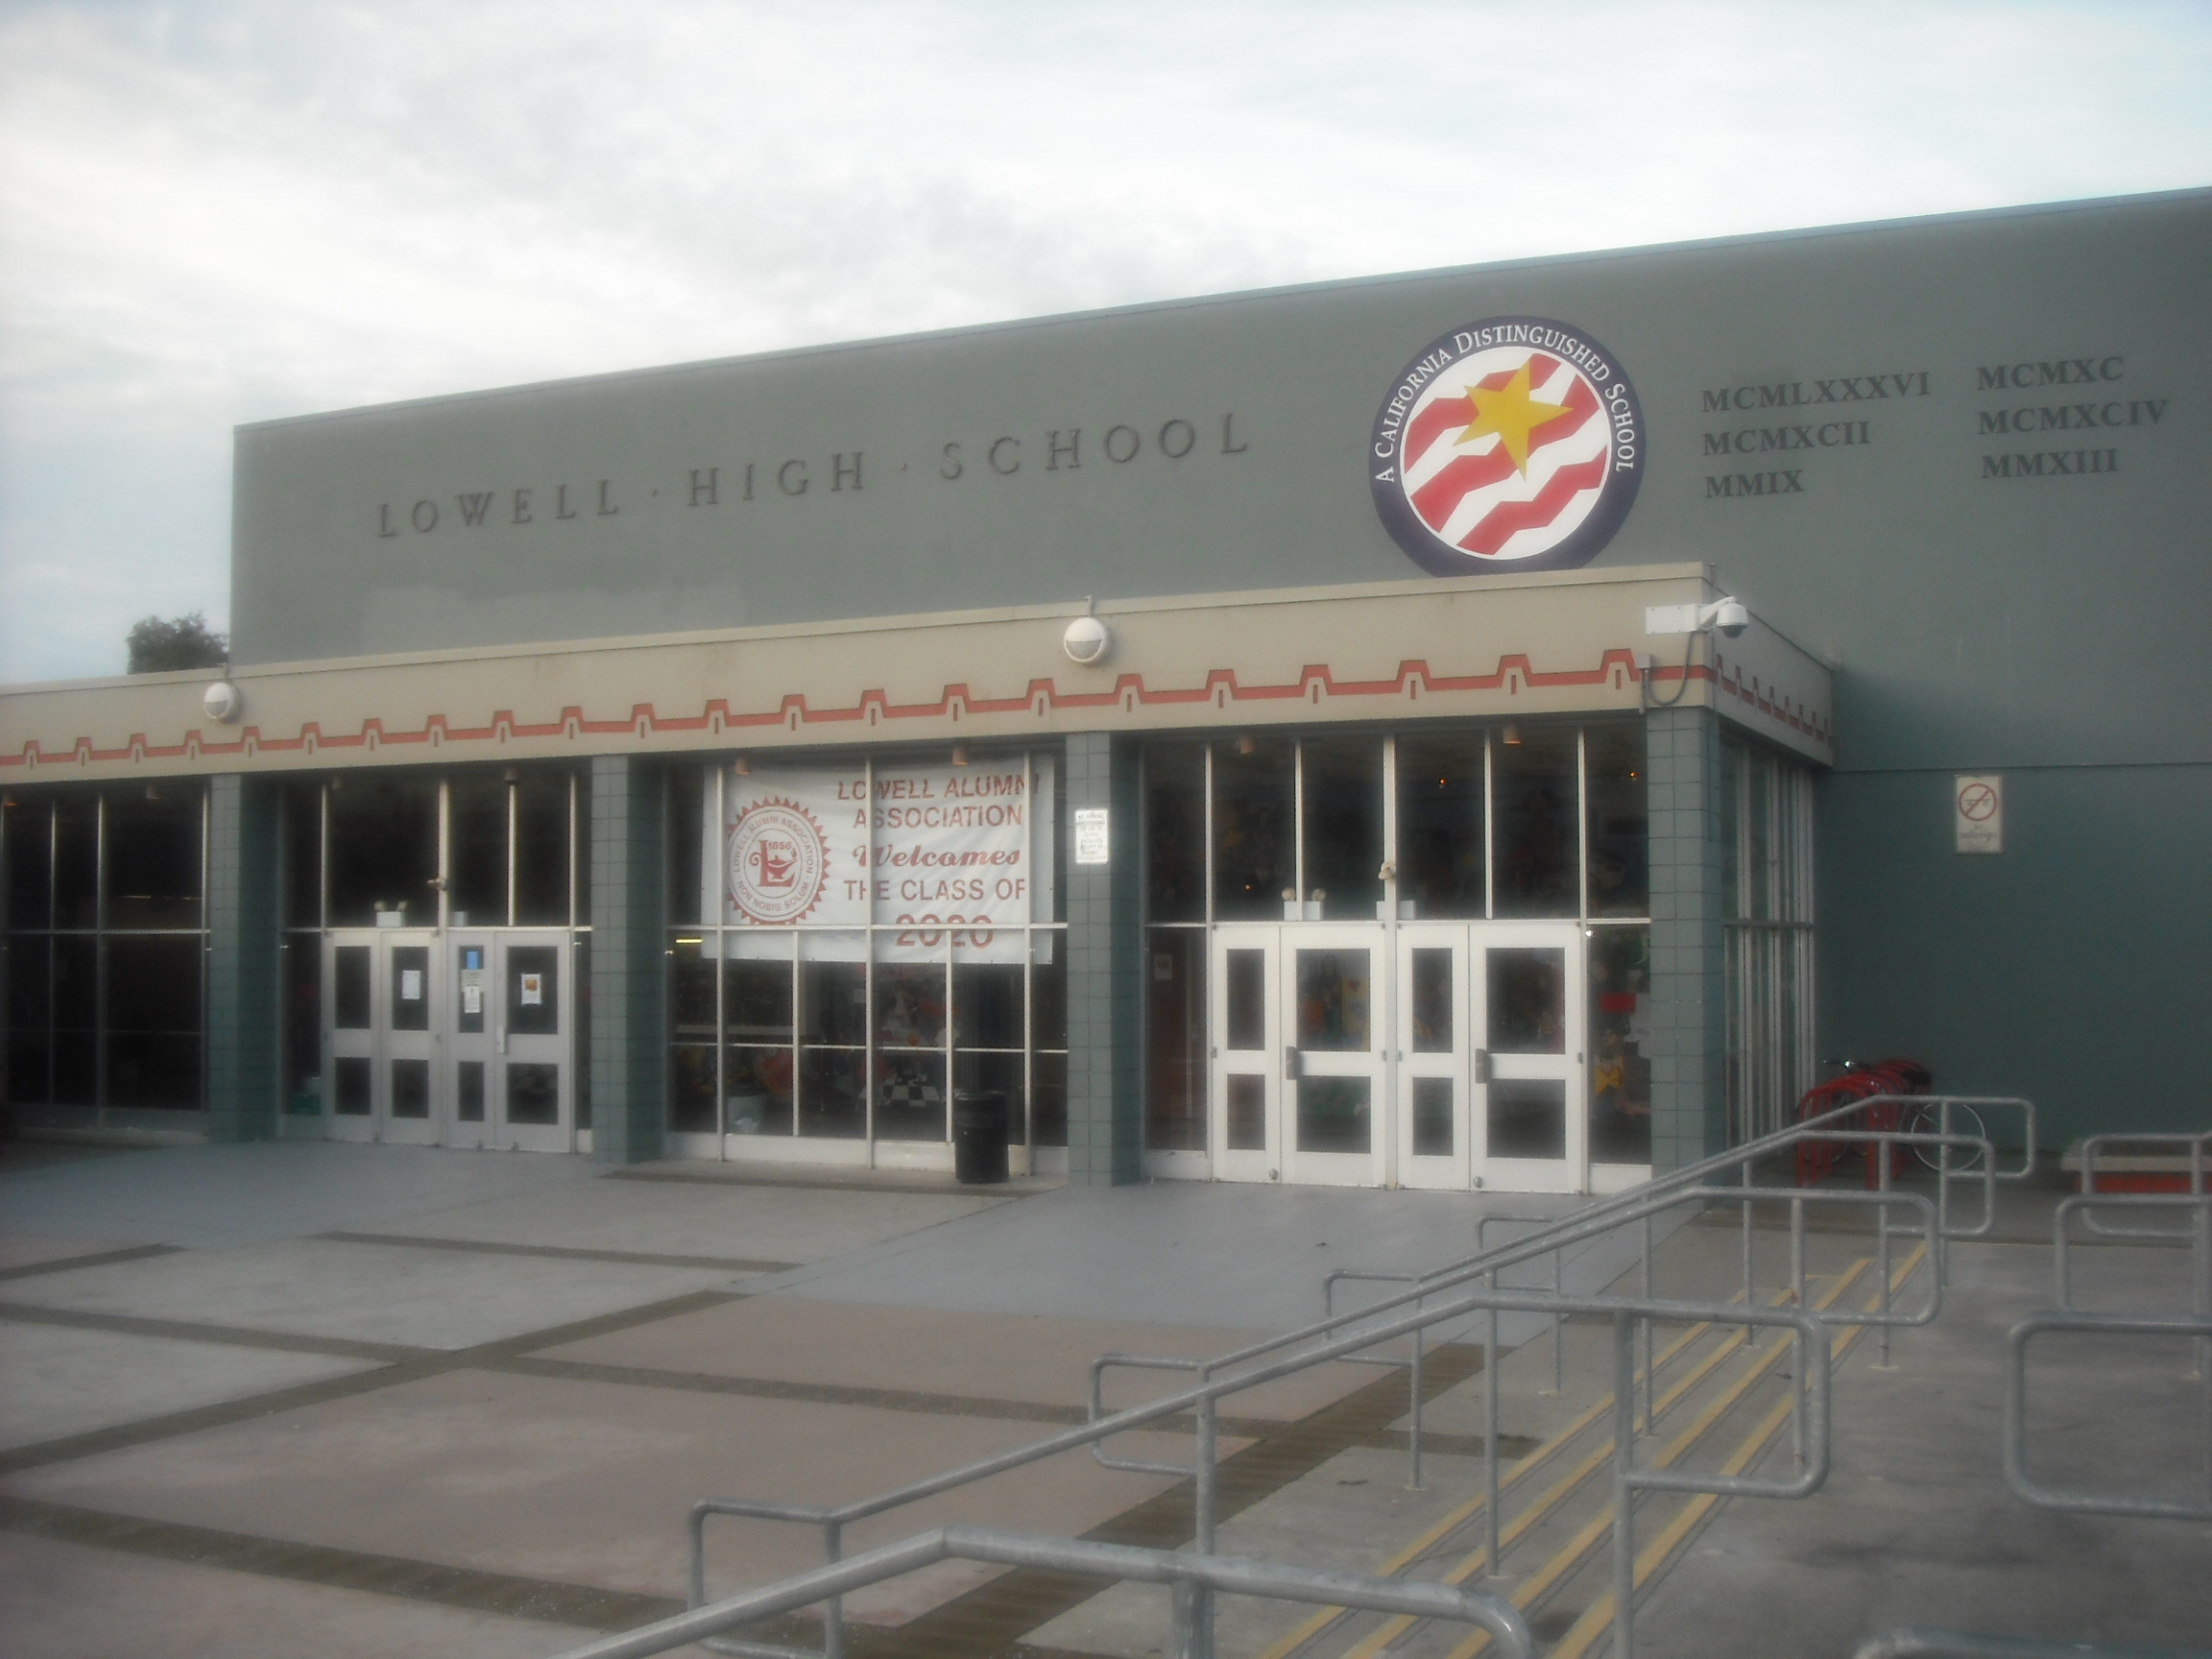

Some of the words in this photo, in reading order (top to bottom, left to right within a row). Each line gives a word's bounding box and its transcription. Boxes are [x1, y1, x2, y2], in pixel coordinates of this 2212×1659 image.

[1454, 325, 1611, 382] DISTINGUISHED
[1976, 356, 2125, 391] MCMXC
[1374, 348, 1453, 459] CALIFORNIA
[1702, 371, 1931, 413] MCMLXXXVI
[1604, 383, 1636, 472] SCHOOL
[1977, 399, 2169, 436] MCMXCIV
[1702, 420, 1871, 457] MCMXCII
[377, 479, 619, 538] LOWELL
[687, 450, 864, 507] HIGH
[939, 412, 1249, 480] SCHOOL
[1375, 466, 1395, 483] A
[1981, 448, 2119, 480] MMXIII
[1705, 469, 1805, 499] MMIX
[837, 779, 935, 801] LOWELL
[853, 804, 1023, 829] ASSOCIATION
[733, 833, 751, 873] LOWELL
[781, 817, 813, 874] ASSOCIATION
[852, 844, 1021, 868] Welcomes
[736, 880, 753, 901] NON
[783, 881, 809, 909] SOLUM
[900, 878, 985, 902] CLASS
[995, 878, 1026, 901] OF
[895, 913, 994, 950] 2020
